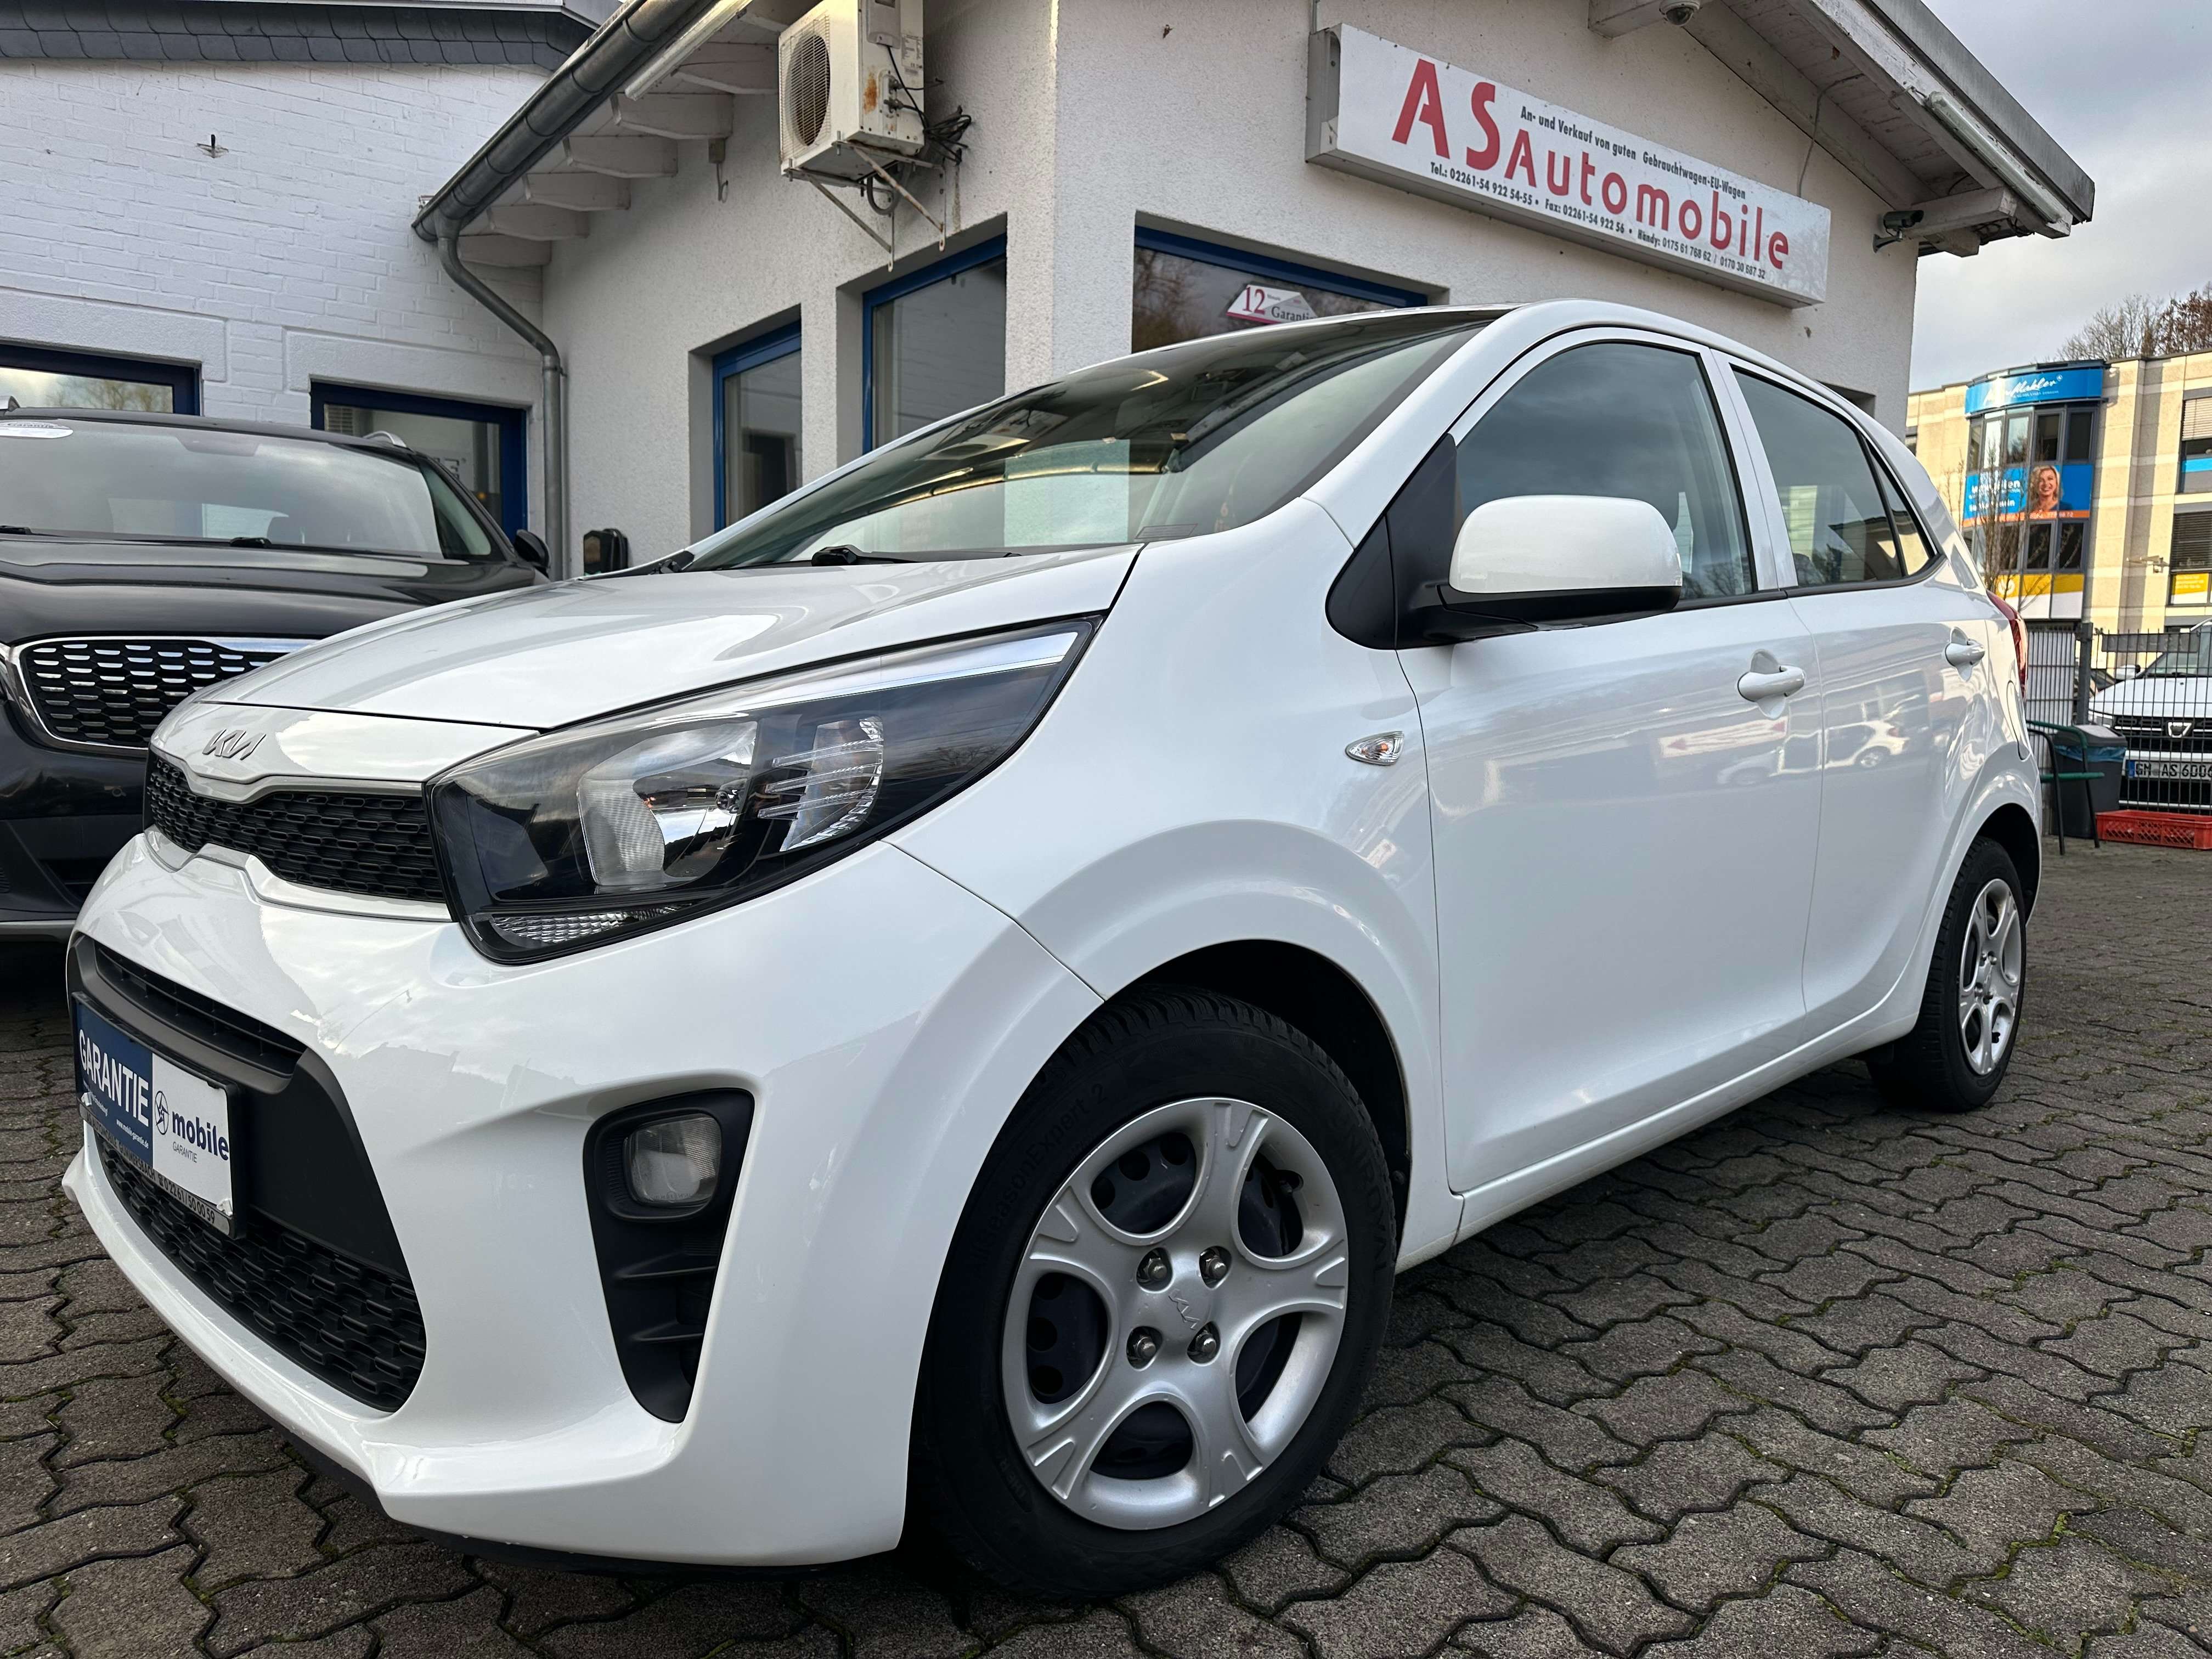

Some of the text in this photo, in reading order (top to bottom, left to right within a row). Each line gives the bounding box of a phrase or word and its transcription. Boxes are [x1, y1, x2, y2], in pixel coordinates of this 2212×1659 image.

[1538, 117, 1555, 130] und
[1558, 119, 1593, 144] Verkauf
[1595, 138, 1610, 150] von
[1612, 143, 1637, 160] guten
[1430, 162, 1448, 178] Tel.:
[1450, 168, 1489, 191] 02261-54
[1492, 182, 1508, 197] 922
[1510, 188, 1533, 205] 54-55
[1545, 198, 1561, 213] Fax:
[1563, 205, 1598, 225] 02261-54
[1600, 217, 1614, 230] 922
[1616, 222, 1624, 234] 56
[1662, 238, 1679, 251] 0175
[1720, 256, 1735, 269] 0170
[1504, 129, 1788, 270] Automobile
[1243, 286, 1318, 321] 12 Garanti
[2136, 763, 2152, 776] GM
[2162, 764, 2178, 777] AS
[80, 1029, 149, 1127] GARANTIE
[172, 1110, 229, 1161] mobile
[173, 1141, 198, 1163] GARANTIE
